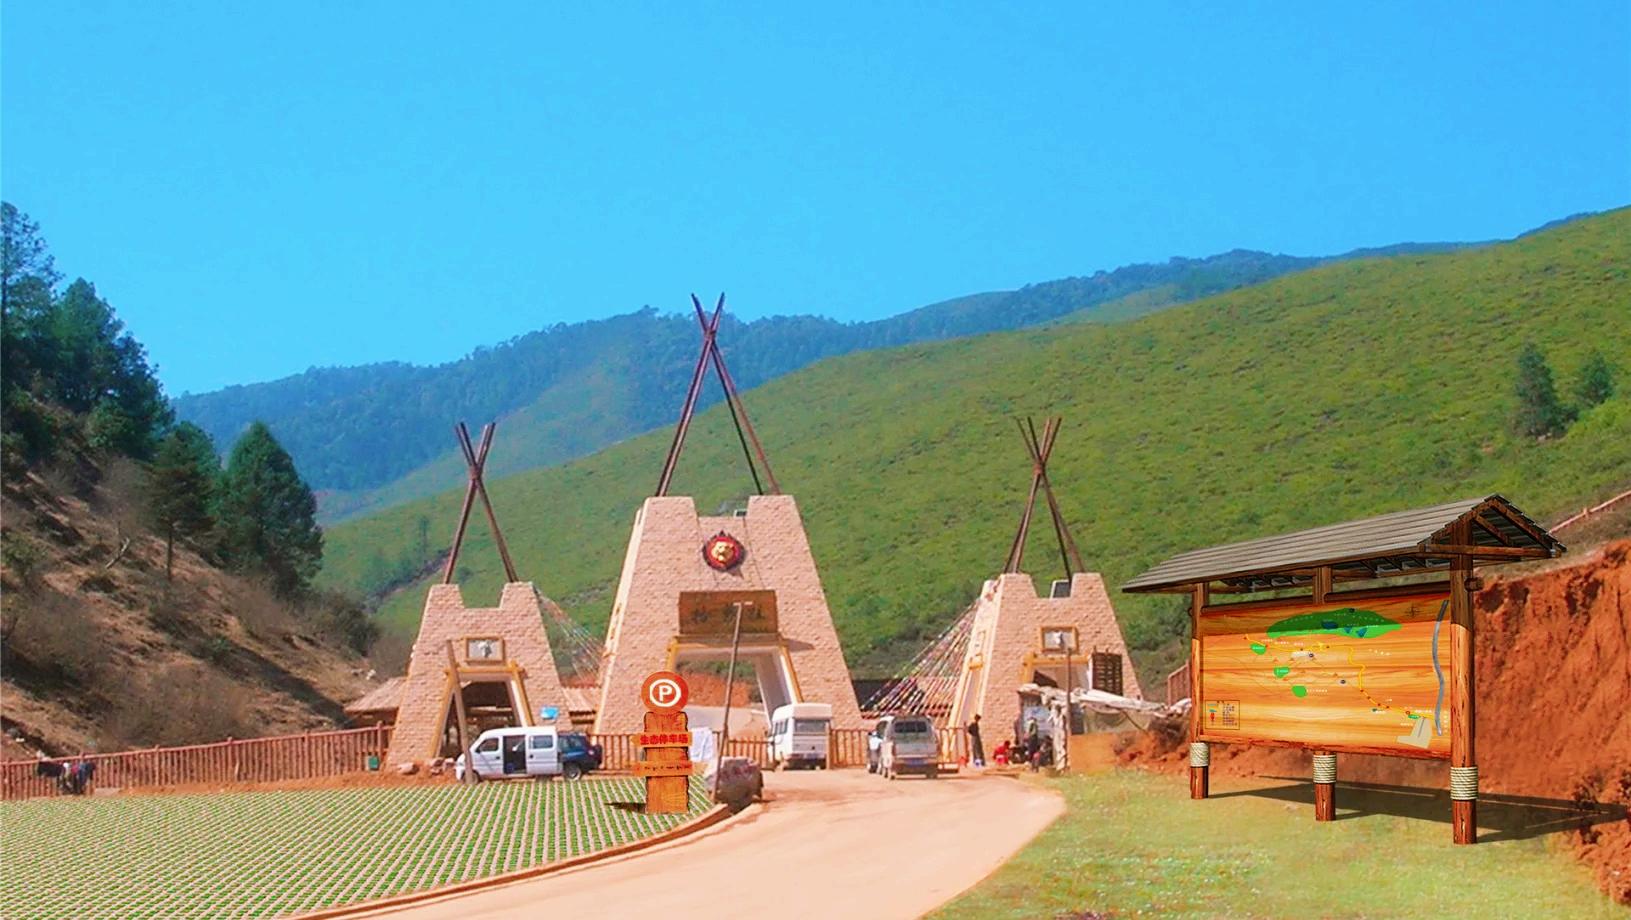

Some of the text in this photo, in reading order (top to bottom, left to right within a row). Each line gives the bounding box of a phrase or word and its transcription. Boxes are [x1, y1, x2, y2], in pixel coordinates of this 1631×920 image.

[659, 685, 672, 701] P
[640, 734, 688, 745] 生态停车场
